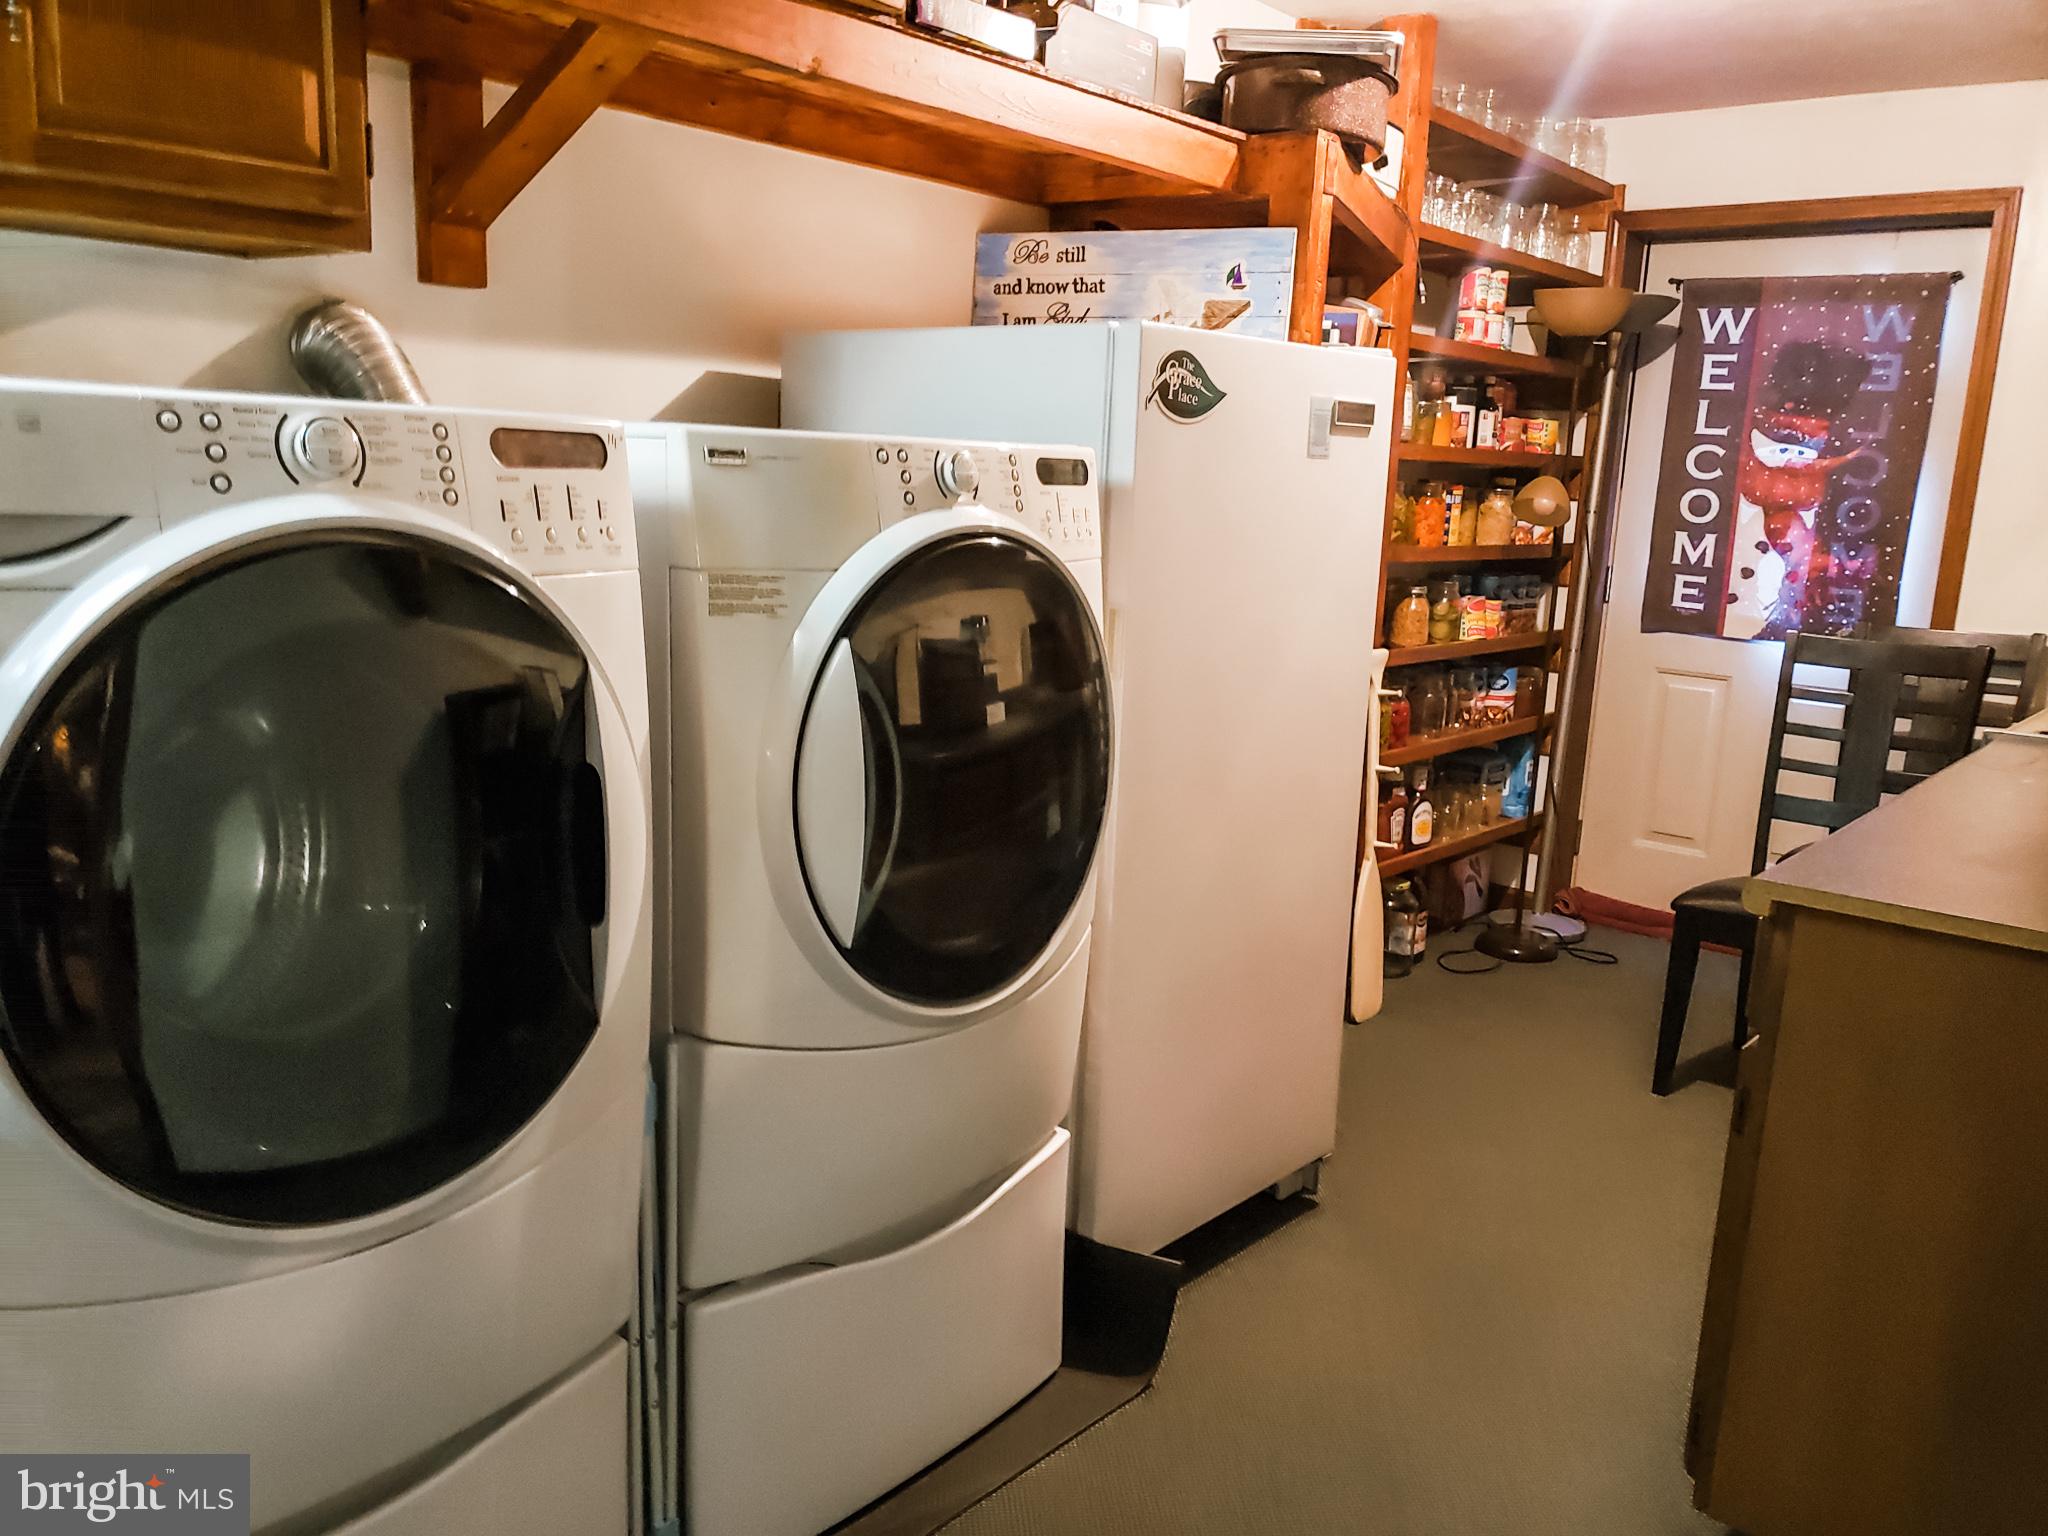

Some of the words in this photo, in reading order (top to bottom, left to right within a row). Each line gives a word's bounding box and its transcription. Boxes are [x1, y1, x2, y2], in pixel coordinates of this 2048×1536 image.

[1013, 239, 1049, 264] Be
[1056, 245, 1087, 263] still
[993, 278, 1022, 295] and
[1025, 277, 1069, 294] know
[1072, 276, 1105, 293] that
[1002, 313, 1010, 325] I
[1013, 316, 1037, 325] am
[1166, 360, 1203, 390] Grace
[1182, 357, 1195, 372] The
[1168, 376, 1199, 406] Place
[1671, 306, 1756, 611] WELCOME
